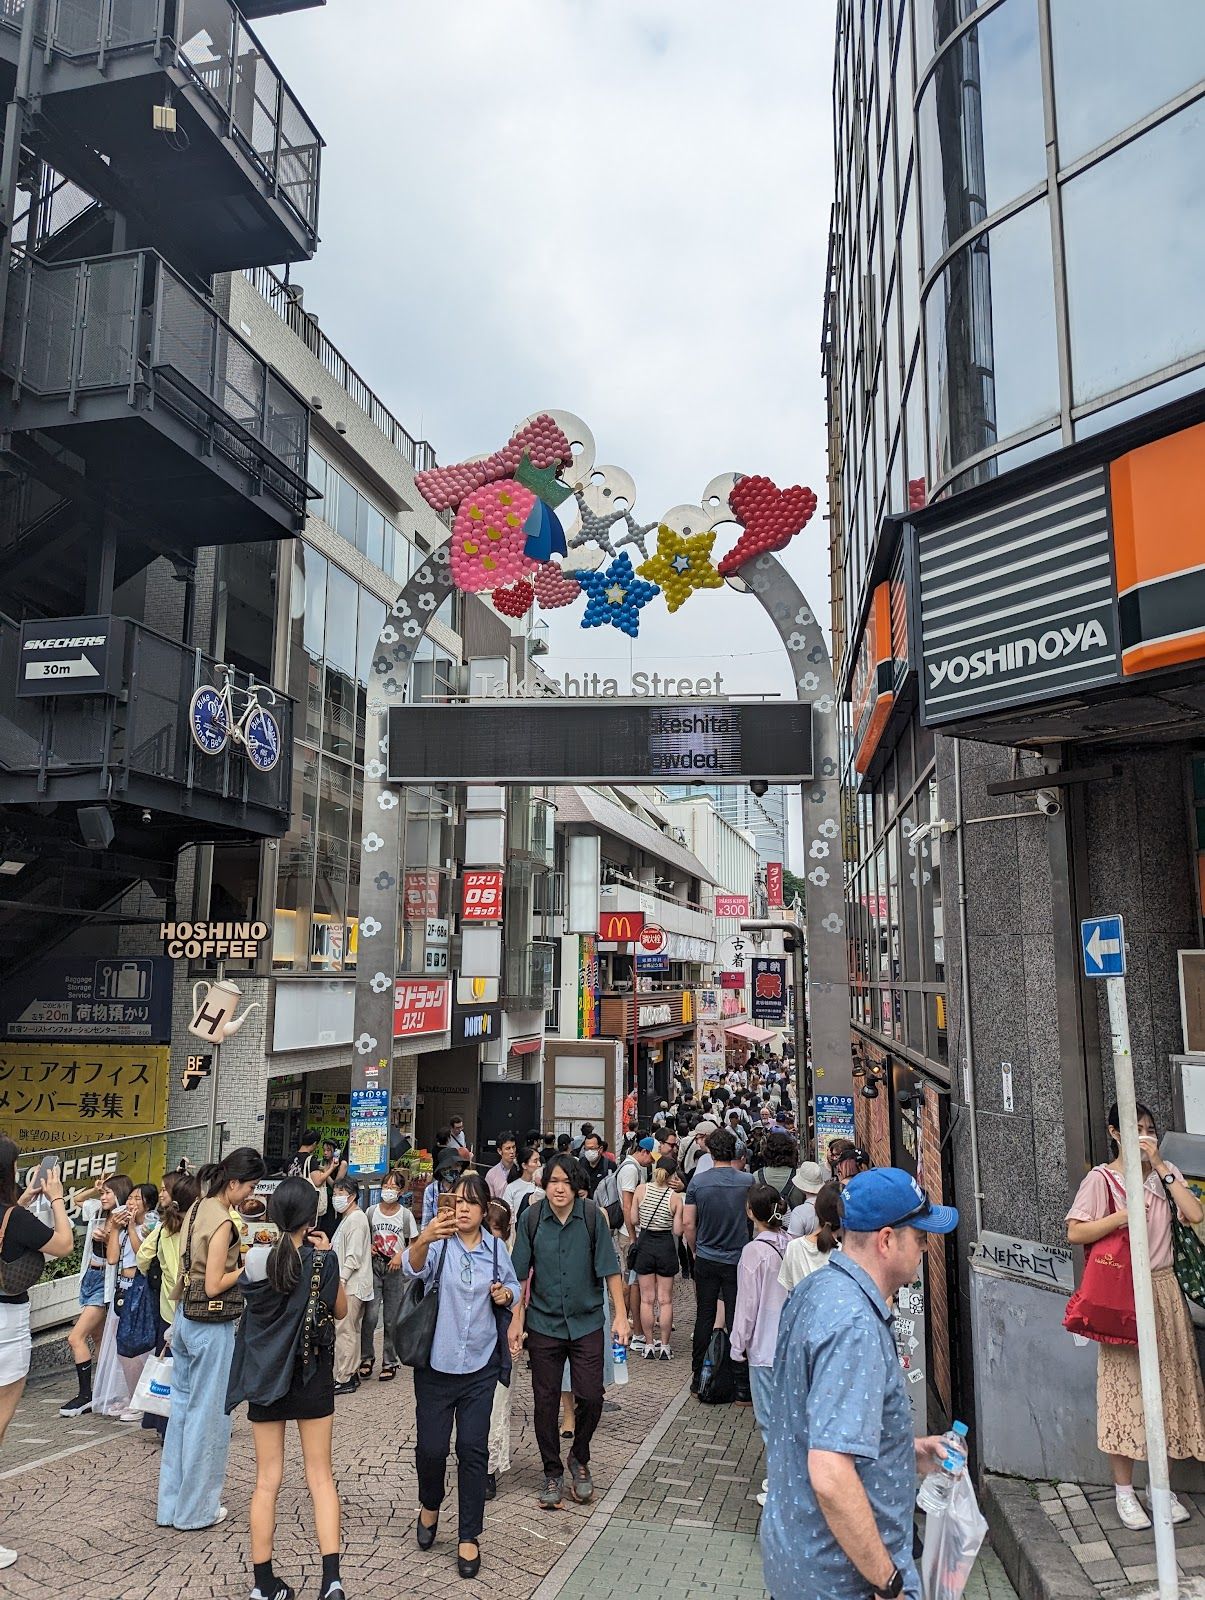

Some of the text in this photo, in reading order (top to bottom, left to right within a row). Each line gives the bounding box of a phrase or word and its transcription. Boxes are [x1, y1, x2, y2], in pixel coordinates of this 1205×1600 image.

[23, 636, 107, 650] SKECHERS
[928, 619, 1107, 690] YOSHINOYA
[43, 665, 70, 675] 30m
[475, 671, 726, 698] Takeshita Street
[197, 693, 210, 709] Bike
[195, 715, 209, 748] Honey
[467, 876, 496, 885] クスリ
[465, 889, 497, 904] OS
[159, 922, 268, 940] HOSHINO
[168, 940, 258, 959] COFFEE
[731, 937, 746, 968] 古着
[67, 983, 92, 991] Storage
[68, 991, 91, 999] Service
[76, 1004, 149, 1021] 荷物預かり
[194, 1002, 225, 1034] H
[187, 1056, 204, 1070] BF
